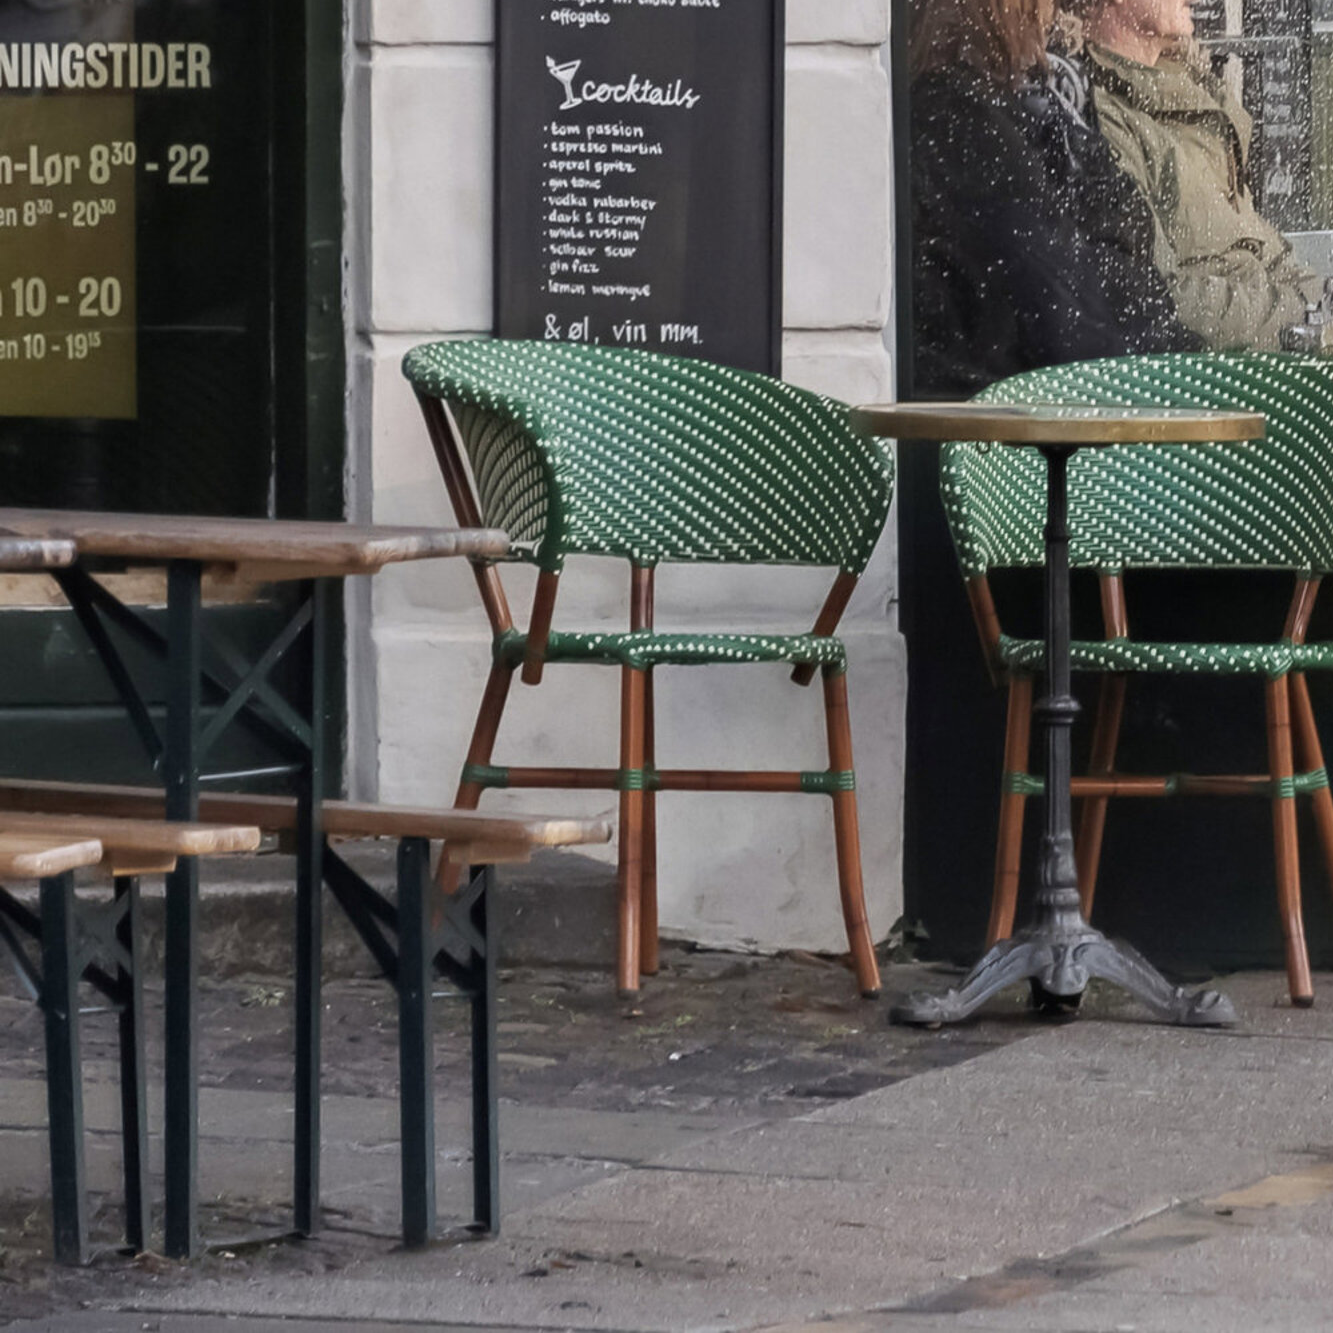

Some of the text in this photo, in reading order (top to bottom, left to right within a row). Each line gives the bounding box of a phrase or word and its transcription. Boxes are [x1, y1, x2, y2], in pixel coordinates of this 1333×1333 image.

[0, 42, 211, 89] NINGSTIDER
[581, 73, 701, 109] cocktails
[586, 120, 645, 141] passion
[167, 144, 210, 184] 22
[11, 276, 47, 318] 10
[78, 276, 122, 317] 20
[23, 333, 46, 359] 10
[543, 313, 563, 341] &
[611, 318, 648, 344] vin
